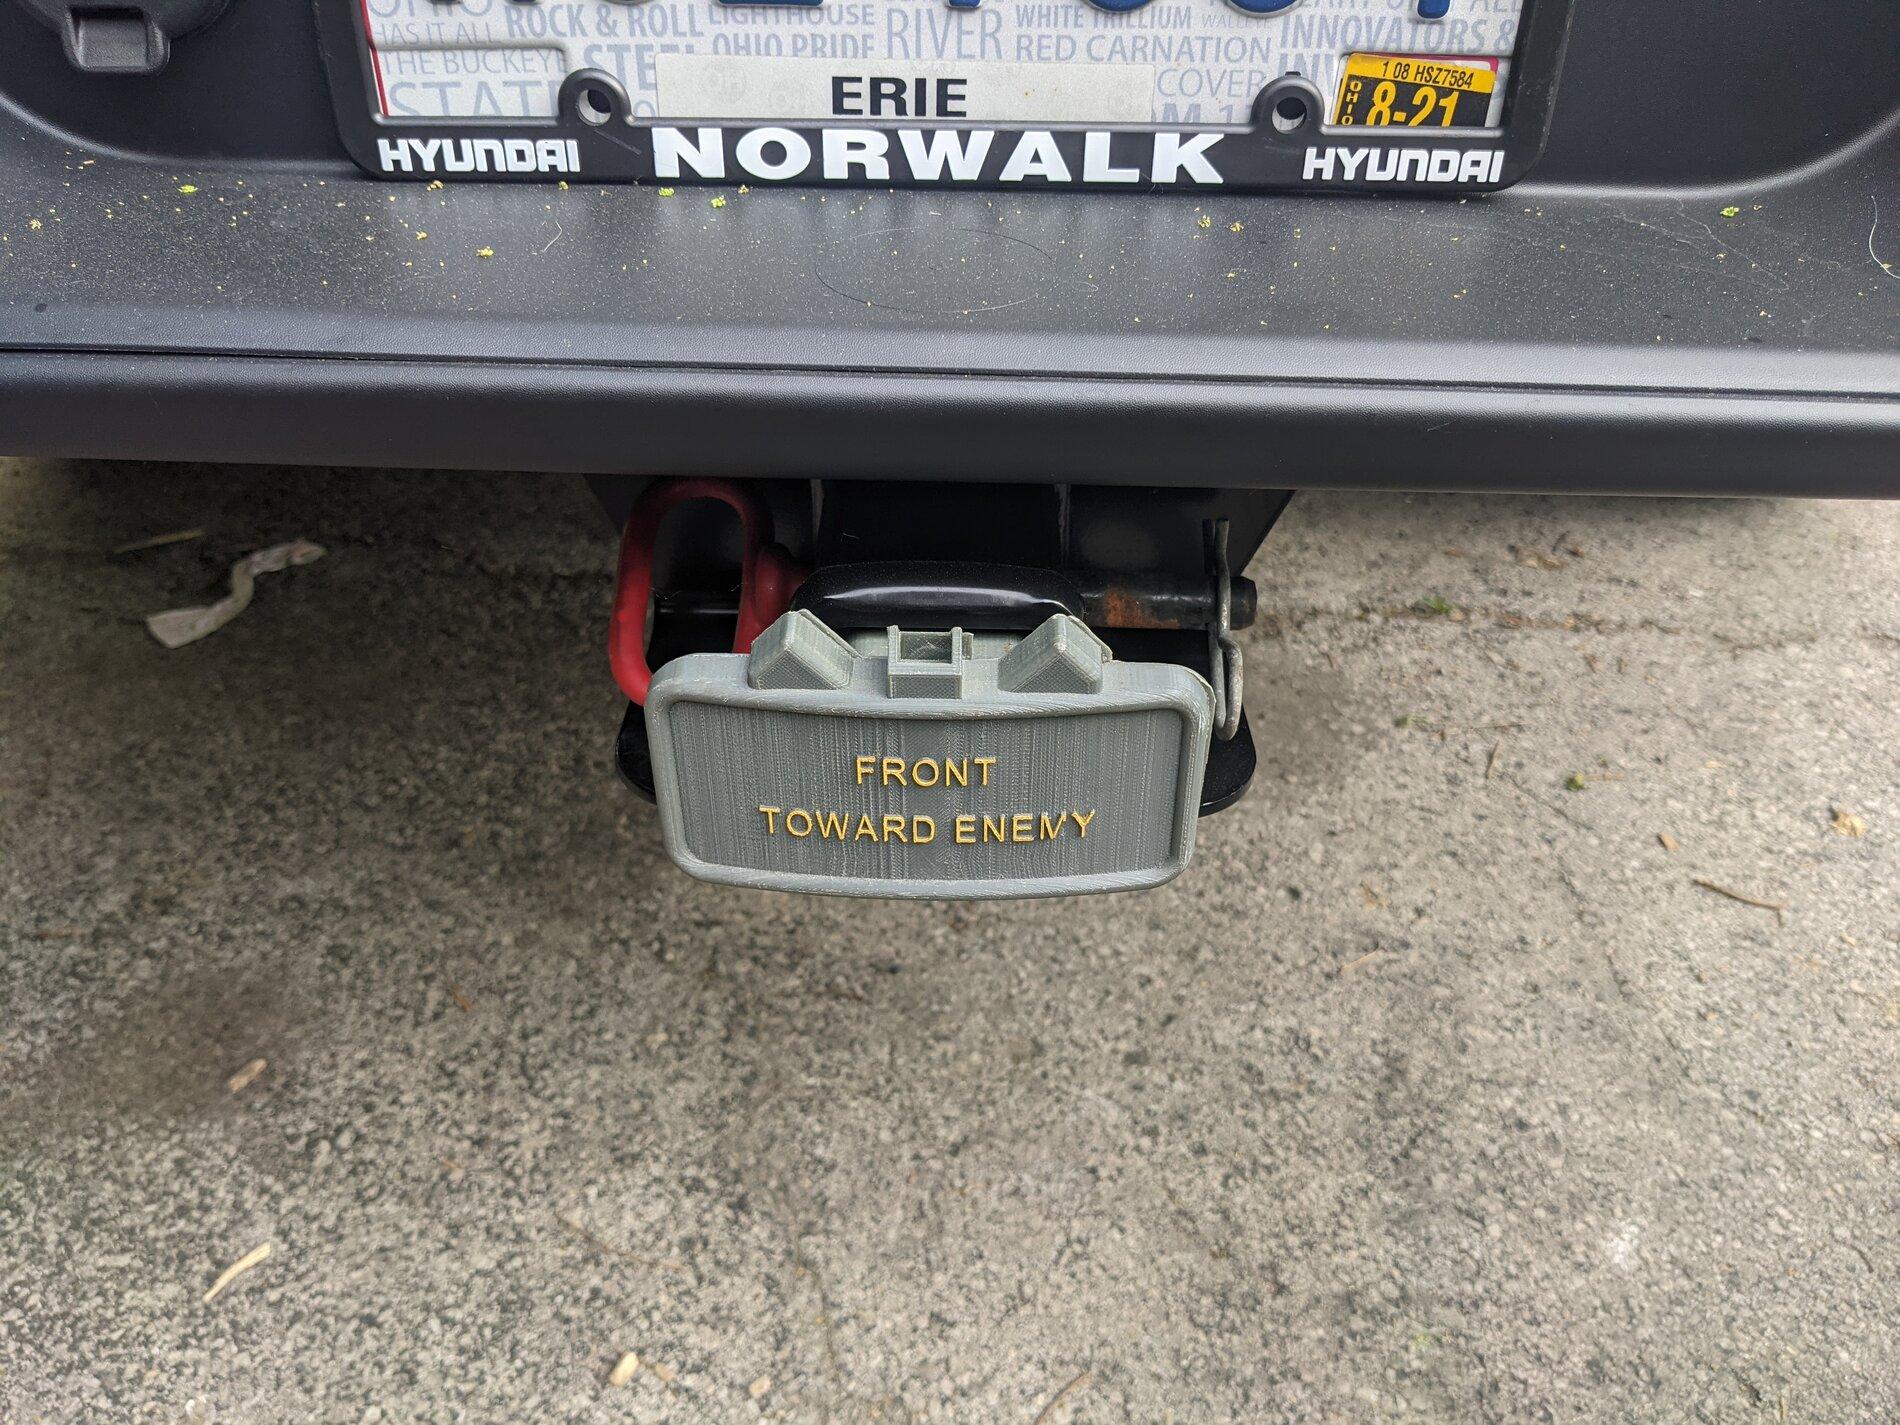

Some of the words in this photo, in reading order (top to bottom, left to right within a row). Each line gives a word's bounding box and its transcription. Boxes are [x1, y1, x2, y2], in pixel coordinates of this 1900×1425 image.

[505, 4, 588, 37] ROCK
[597, 4, 619, 37] &
[626, 4, 704, 37] ROLL
[709, 4, 875, 25] LIGHTHOUSE
[1016, 5, 1084, 28] WHITE
[426, 22, 445, 44] IT
[456, 22, 501, 44] ALL
[887, 8, 1002, 59] RIVER
[1016, 35, 1076, 61] RED
[1086, 35, 1271, 63] CARNATION
[1281, 15, 1487, 53] INNOVATORS
[383, 50, 435, 74] THE
[443, 50, 568, 74] BUCKEYE
[1382, 61, 1389, 77] 1
[1393, 62, 1411, 80] 08
[1414, 65, 1474, 88] HSZ7584
[832, 76, 967, 117] ERIE
[1366, 81, 1460, 127] 8-21
[377, 139, 581, 172] HYUNDAI
[651, 127, 1224, 184] NORWALK
[1302, 147, 1505, 183] HYUNDAI
[856, 755, 997, 788] FRONT
[758, 805, 937, 844] TOWARD
[955, 809, 1096, 845] ENEMY
